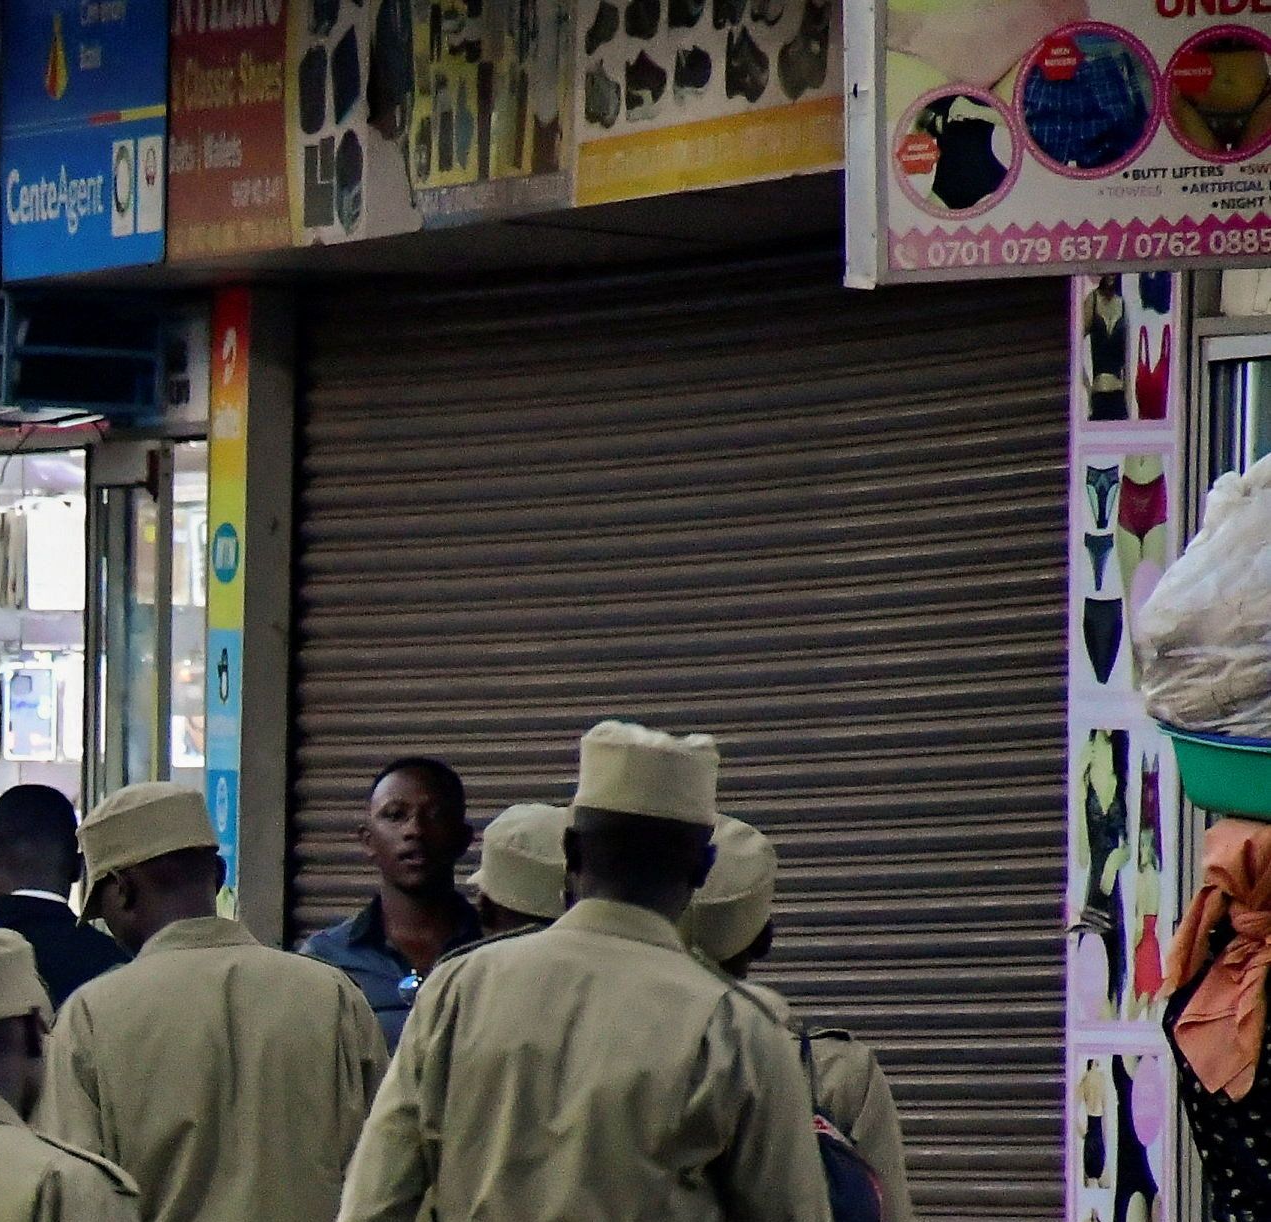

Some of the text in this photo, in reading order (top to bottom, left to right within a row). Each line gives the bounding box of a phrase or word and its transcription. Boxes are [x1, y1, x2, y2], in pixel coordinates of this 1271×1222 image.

[1131, 168, 1168, 181] BUTT
[1172, 165, 1225, 180] LIFTERS
[1189, 180, 1264, 194] ARTIFICIAL
[6, 163, 105, 236] CenteAgent
[1220, 196, 1265, 210] NIGHT
[927, 240, 990, 268] 0701
[1001, 238, 1052, 265] 079
[1059, 236, 1109, 262] 637
[1135, 231, 1201, 259] 0762
